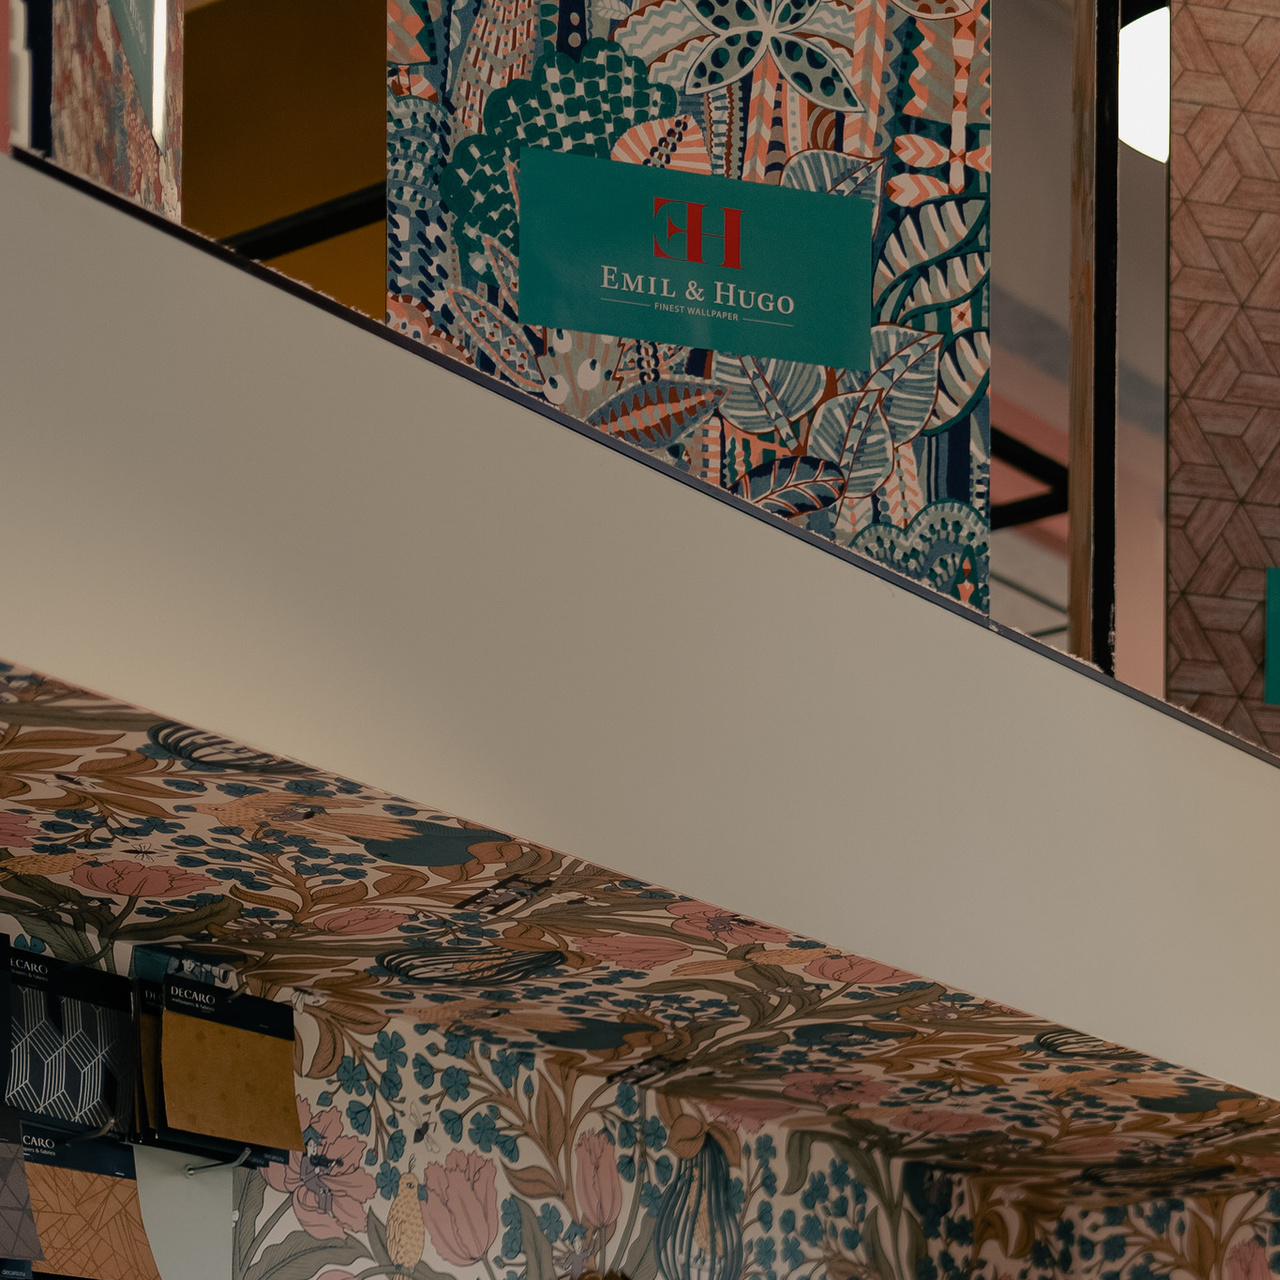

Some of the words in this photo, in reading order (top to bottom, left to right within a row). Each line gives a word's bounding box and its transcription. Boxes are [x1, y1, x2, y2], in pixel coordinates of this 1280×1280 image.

[600, 264, 676, 298] EMIL
[685, 280, 705, 301] &
[713, 281, 795, 315] HUGO
[654, 302, 685, 314] FINEST
[687, 307, 739, 322] WALLPAPER
[170, 985, 216, 1005] DECARO
[22, 1135, 55, 1149] CARO
